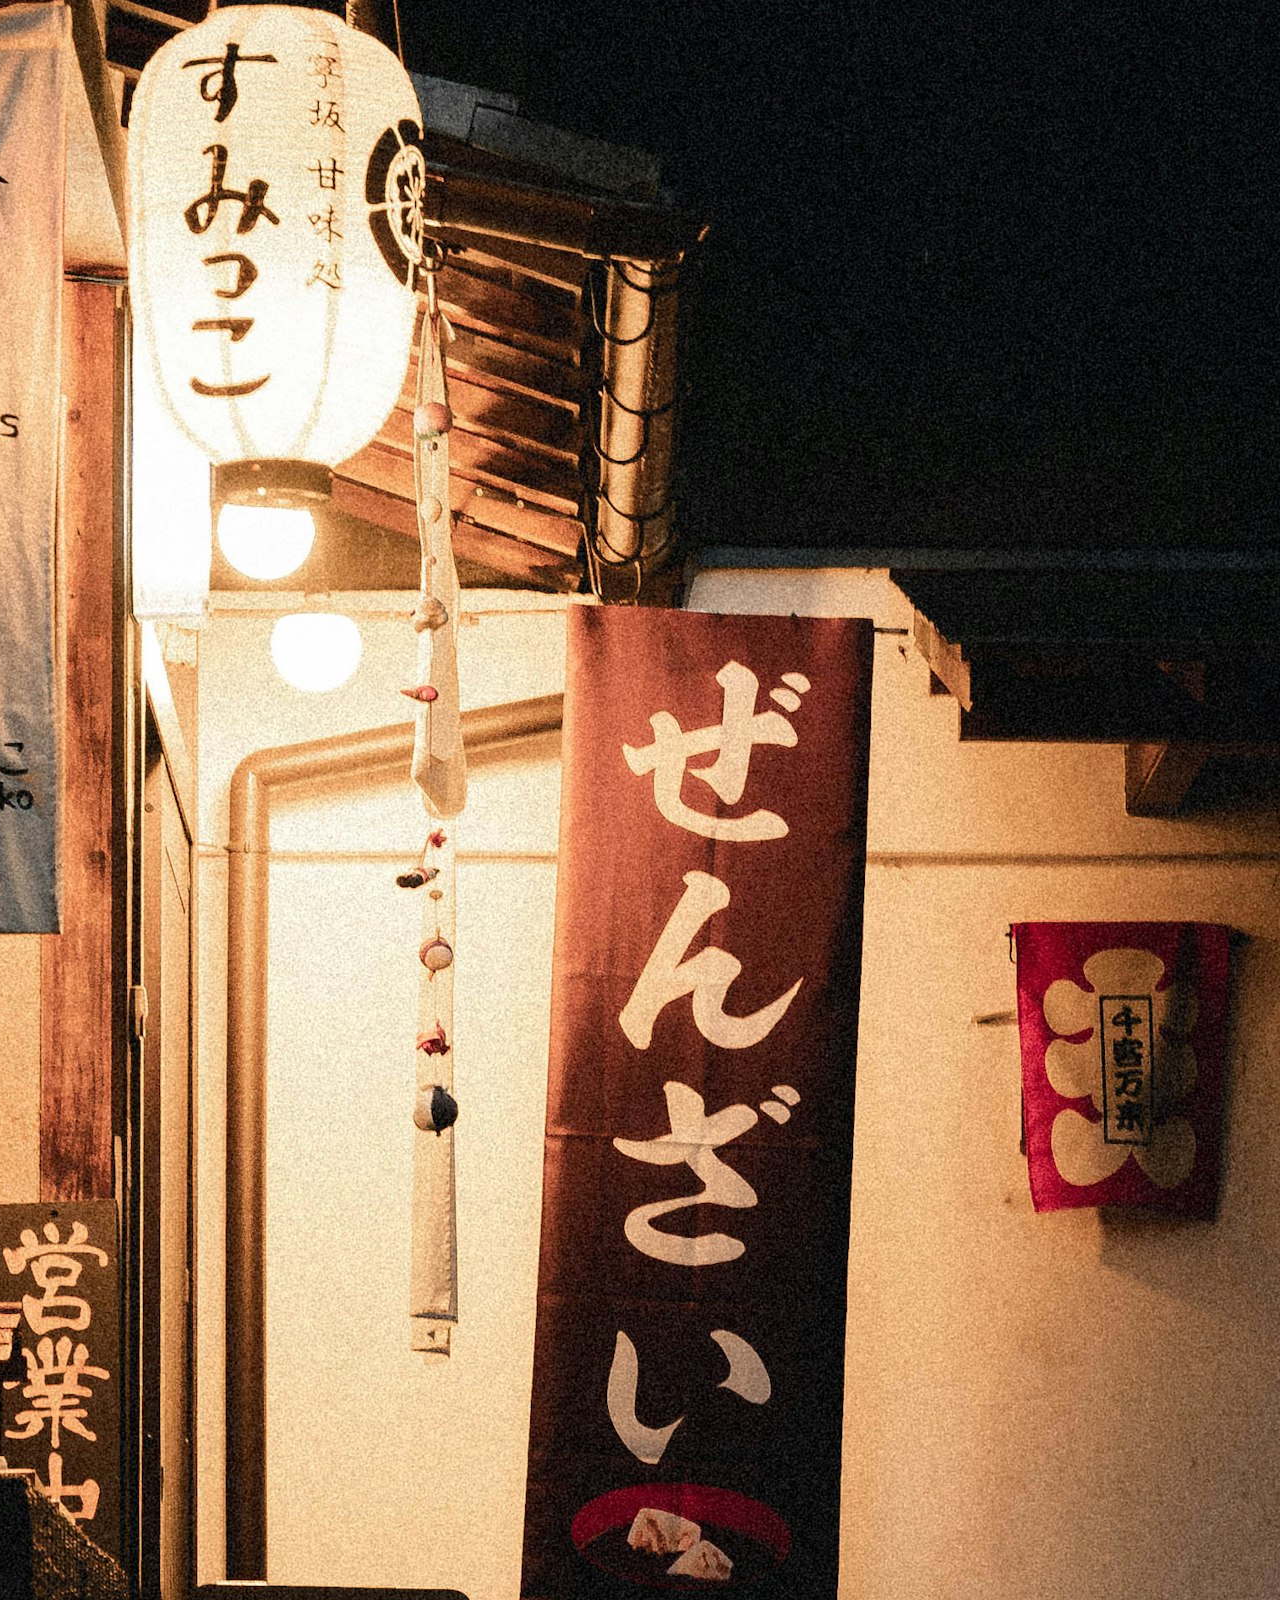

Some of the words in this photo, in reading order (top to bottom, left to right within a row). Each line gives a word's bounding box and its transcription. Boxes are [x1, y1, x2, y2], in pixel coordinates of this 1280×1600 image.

[182, 42, 281, 397] すみっこ
[605, 660, 811, 1465] ぜんざい
